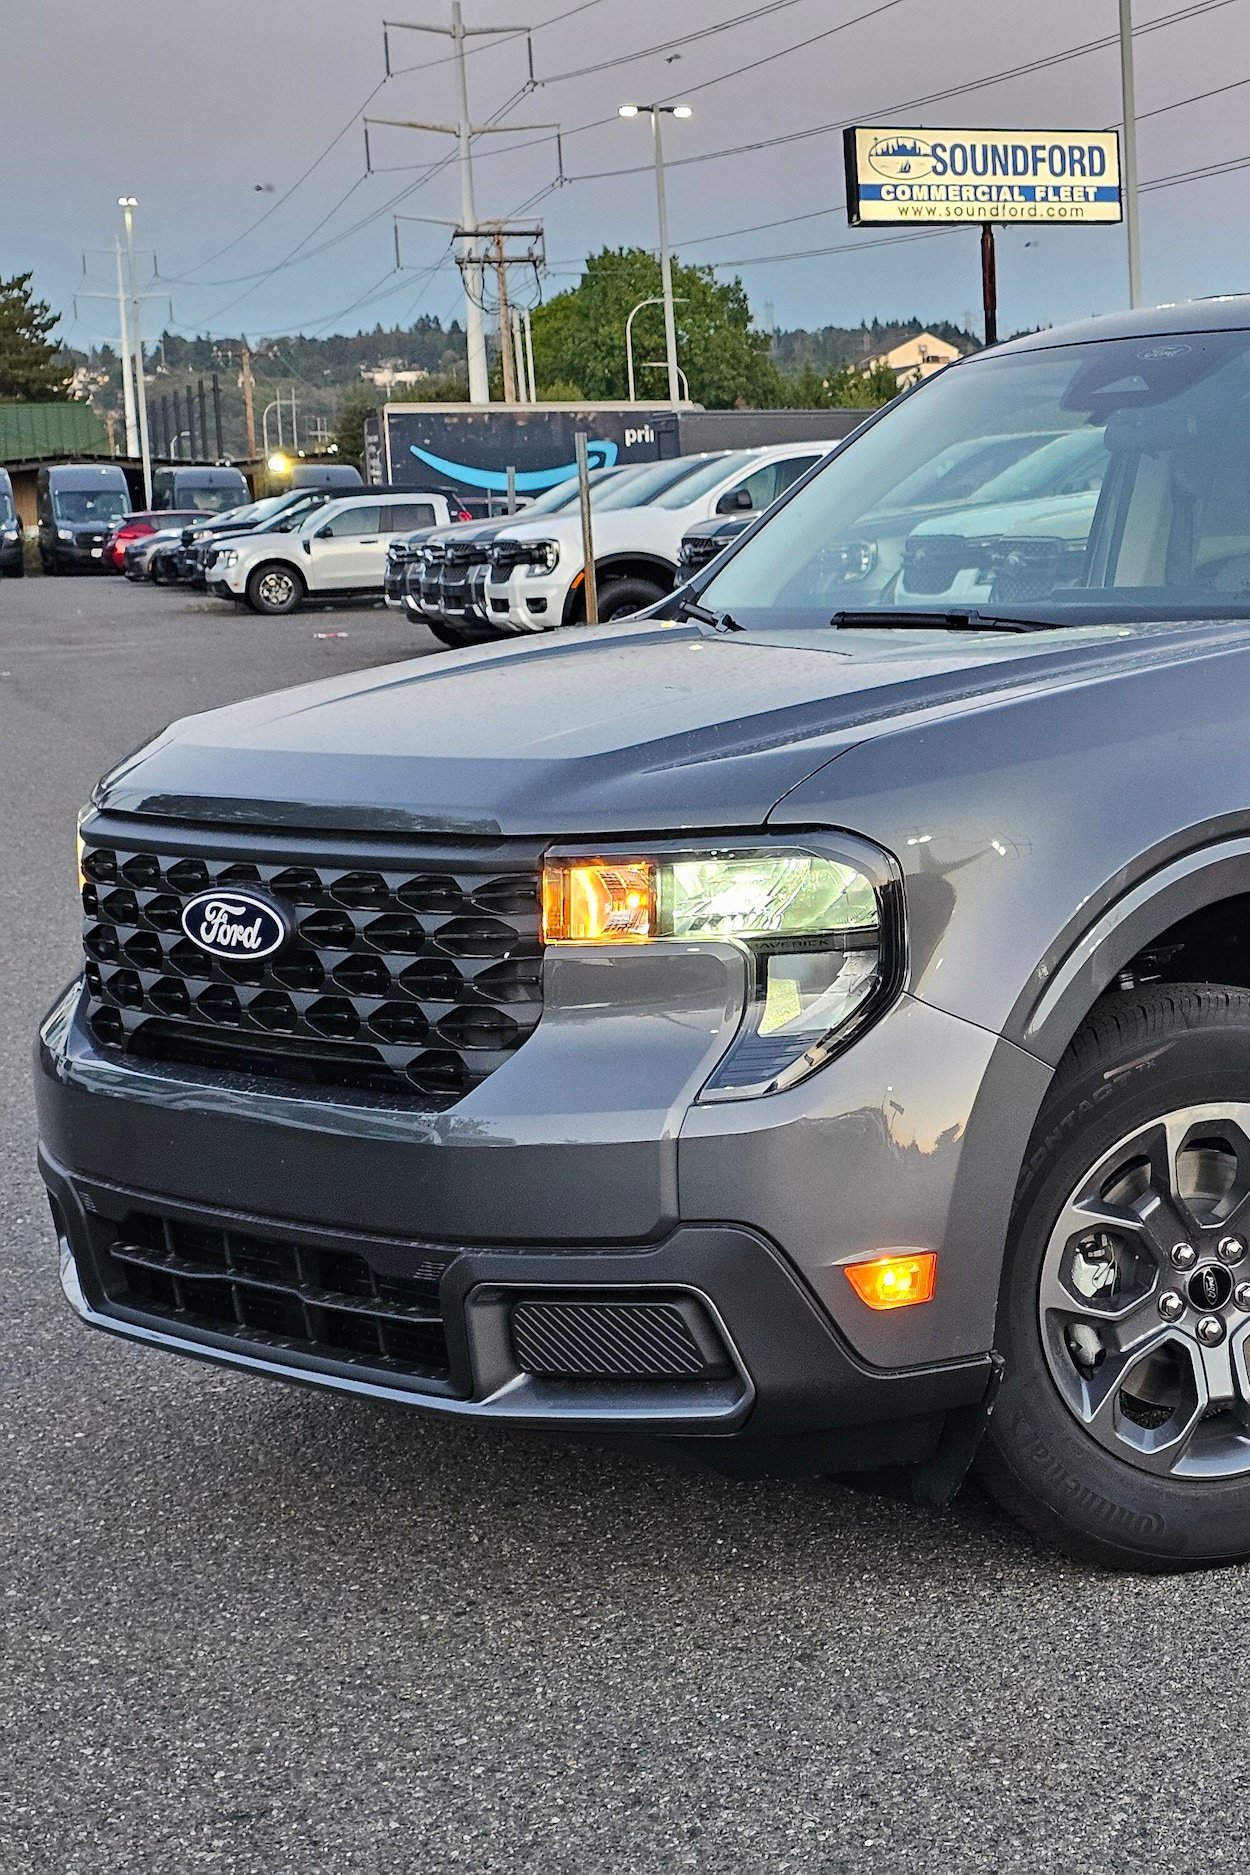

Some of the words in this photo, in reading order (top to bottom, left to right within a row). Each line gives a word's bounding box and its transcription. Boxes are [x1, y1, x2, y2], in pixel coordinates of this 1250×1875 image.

[931, 142, 1106, 177] SOUNDFORD
[880, 184, 1025, 202] COMMERCIAL
[1034, 185, 1098, 202] FLEET
[897, 203, 1084, 218] www.soundford.com
[624, 424, 655, 447] pri
[200, 901, 262, 949] Ford
